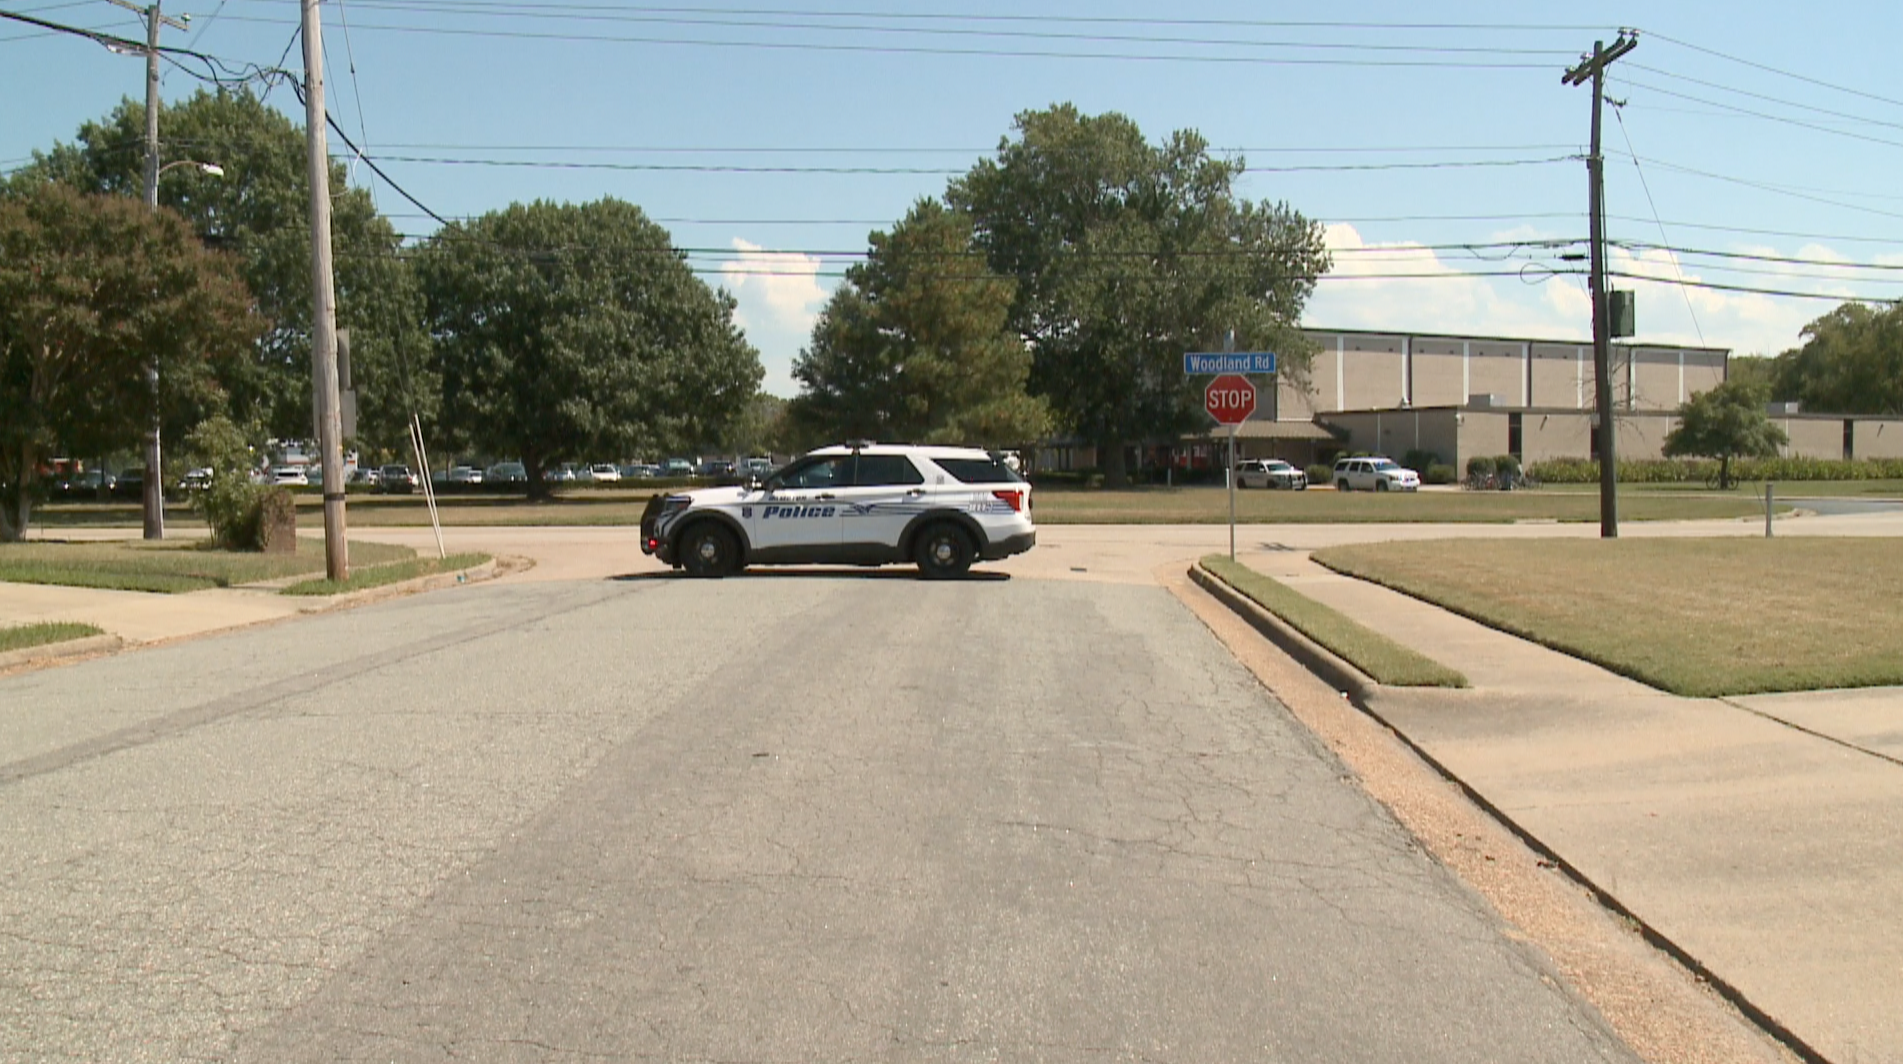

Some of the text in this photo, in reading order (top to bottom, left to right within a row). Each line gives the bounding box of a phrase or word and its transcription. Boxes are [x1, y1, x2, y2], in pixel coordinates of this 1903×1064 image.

[1190, 356, 1269, 371] Woodland Rd
[1208, 389, 1252, 409] STOP
[762, 506, 836, 519] Police
